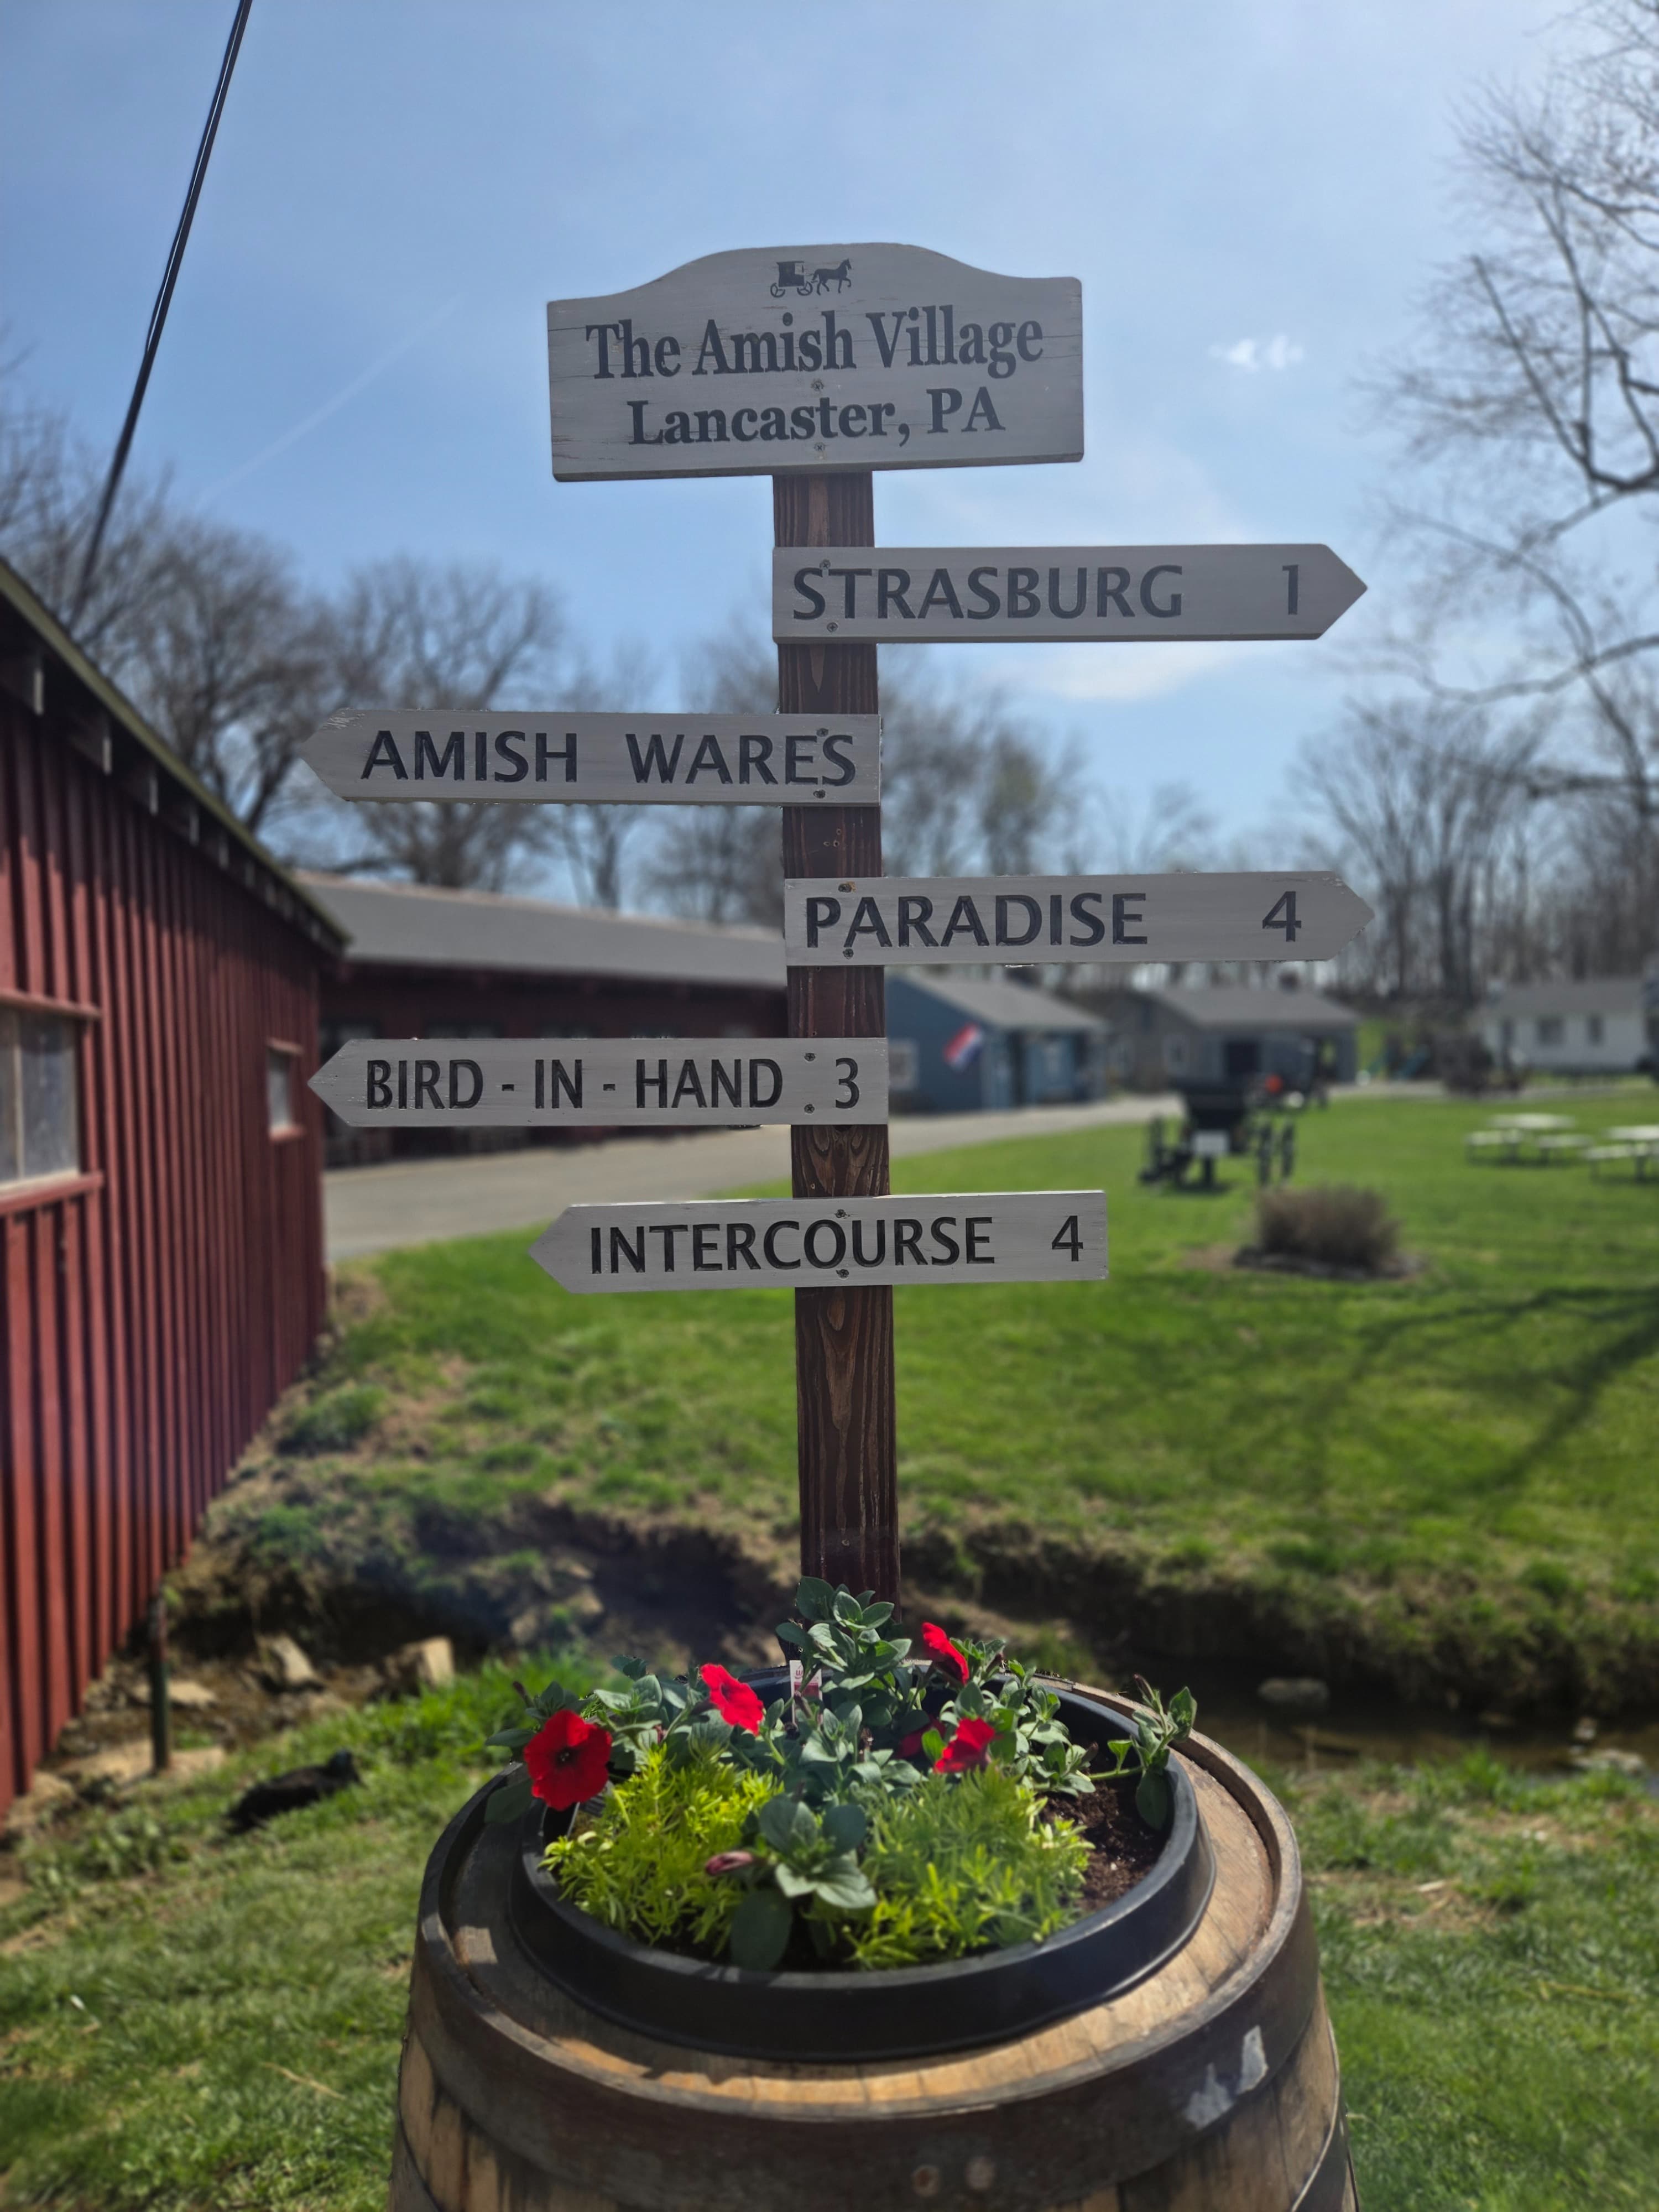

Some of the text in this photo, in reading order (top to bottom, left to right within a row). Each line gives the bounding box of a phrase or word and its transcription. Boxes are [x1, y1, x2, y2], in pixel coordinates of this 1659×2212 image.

[585, 304, 1044, 379] The Amish Village
[626, 386, 1006, 446] Lancaster, PA
[792, 565, 1300, 620] STRASBURG 1
[360, 731, 856, 786] AMISH WARES
[806, 891, 1302, 948] PARADISE 4
[834, 1057, 859, 1109] 3
[591, 1215, 1084, 1274] INTERCOURSE 4
